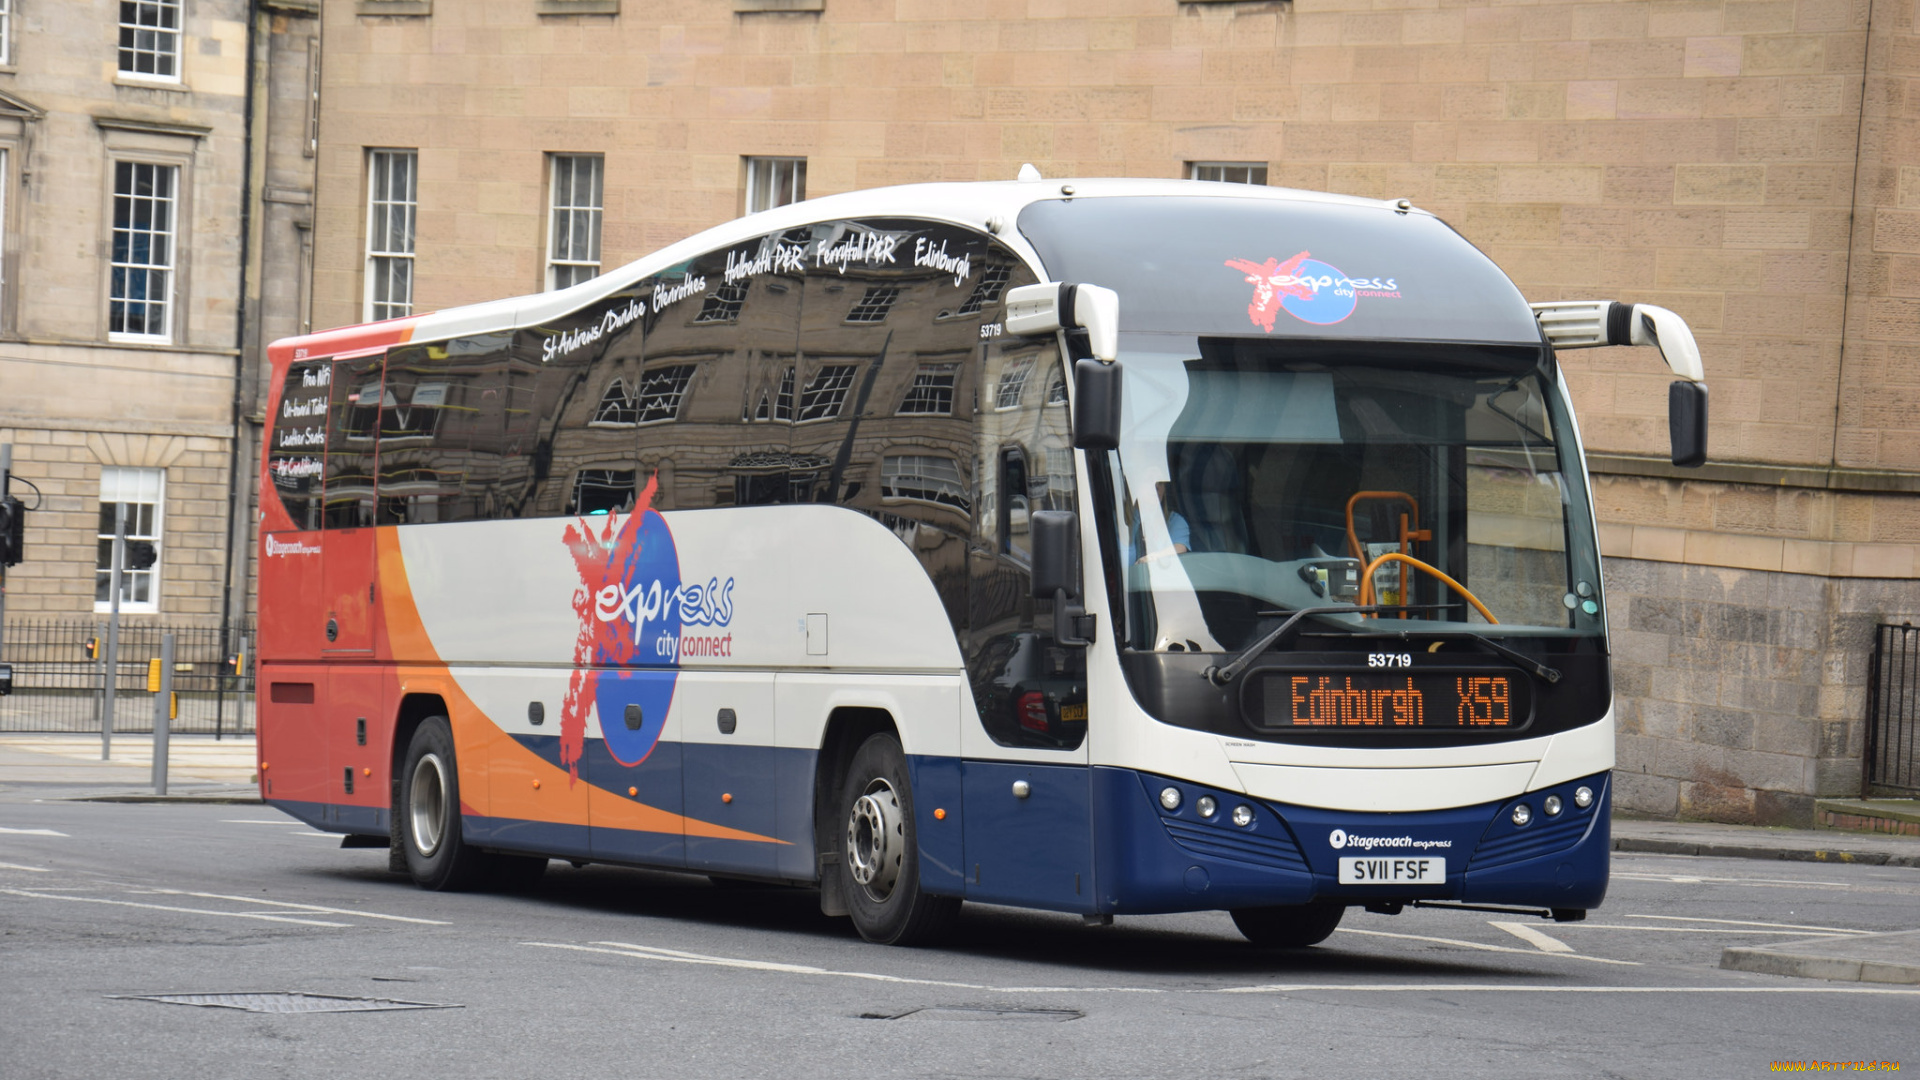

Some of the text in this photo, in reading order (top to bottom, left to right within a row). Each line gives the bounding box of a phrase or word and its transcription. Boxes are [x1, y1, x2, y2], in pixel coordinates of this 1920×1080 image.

[1268, 274, 1398, 293] express
[1334, 287, 1402, 299] city connect
[541, 231, 971, 362] St Andrews/Dundee Glenrothes Halbeath P&R Ferrytoll P&R Edinburgh
[981, 323, 1001, 338] 53719
[302, 369, 317, 388] Free
[311, 396, 328, 417] Toilet
[279, 425, 326, 448] Leather Seats
[277, 456, 324, 481] Air Conditioning
[273, 540, 321, 559] Stagecoach express
[595, 576, 734, 645] express
[656, 629, 732, 664] city connect
[1367, 653, 1412, 668] 53719
[1291, 676, 1510, 726] Edinburgh X59
[1347, 834, 1452, 850] Stagecoach express
[1393, 860, 1430, 880] FSF
